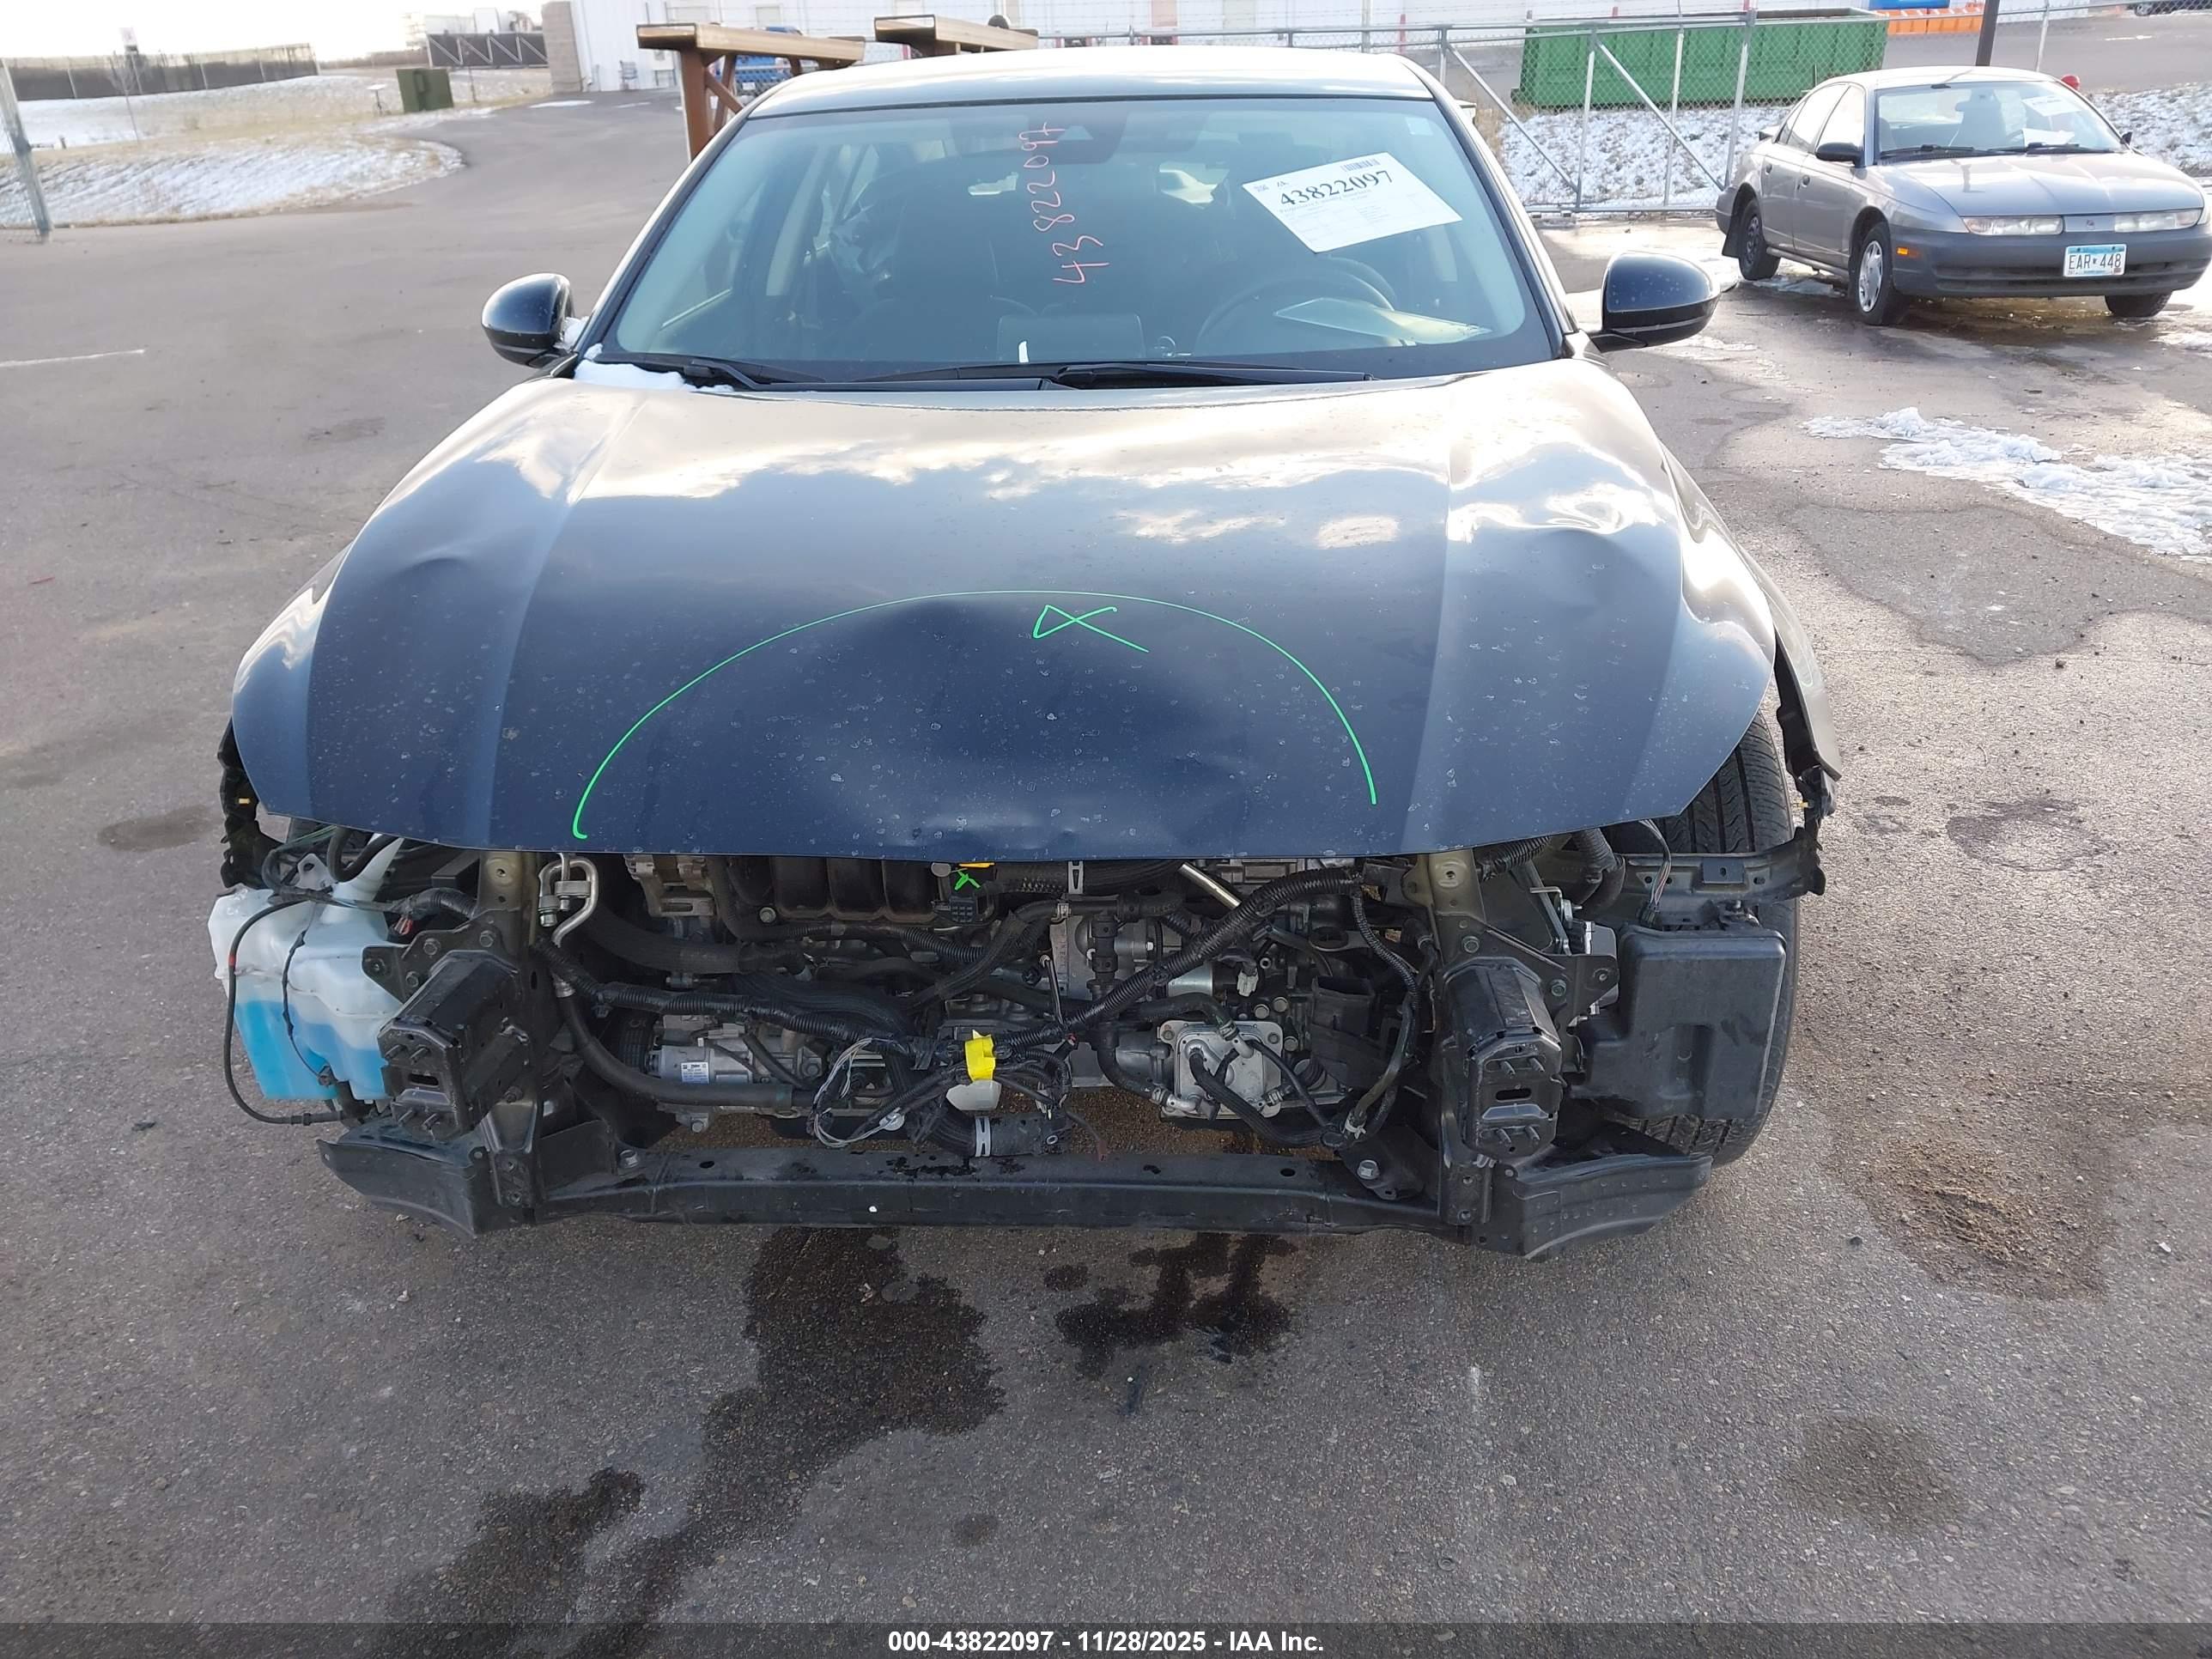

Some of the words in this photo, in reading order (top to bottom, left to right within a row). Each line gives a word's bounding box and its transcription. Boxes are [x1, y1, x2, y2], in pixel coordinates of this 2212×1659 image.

[1280, 170, 1393, 206] 43822097
[2069, 254, 2091, 270] EAR
[2100, 253, 2122, 269] 448
